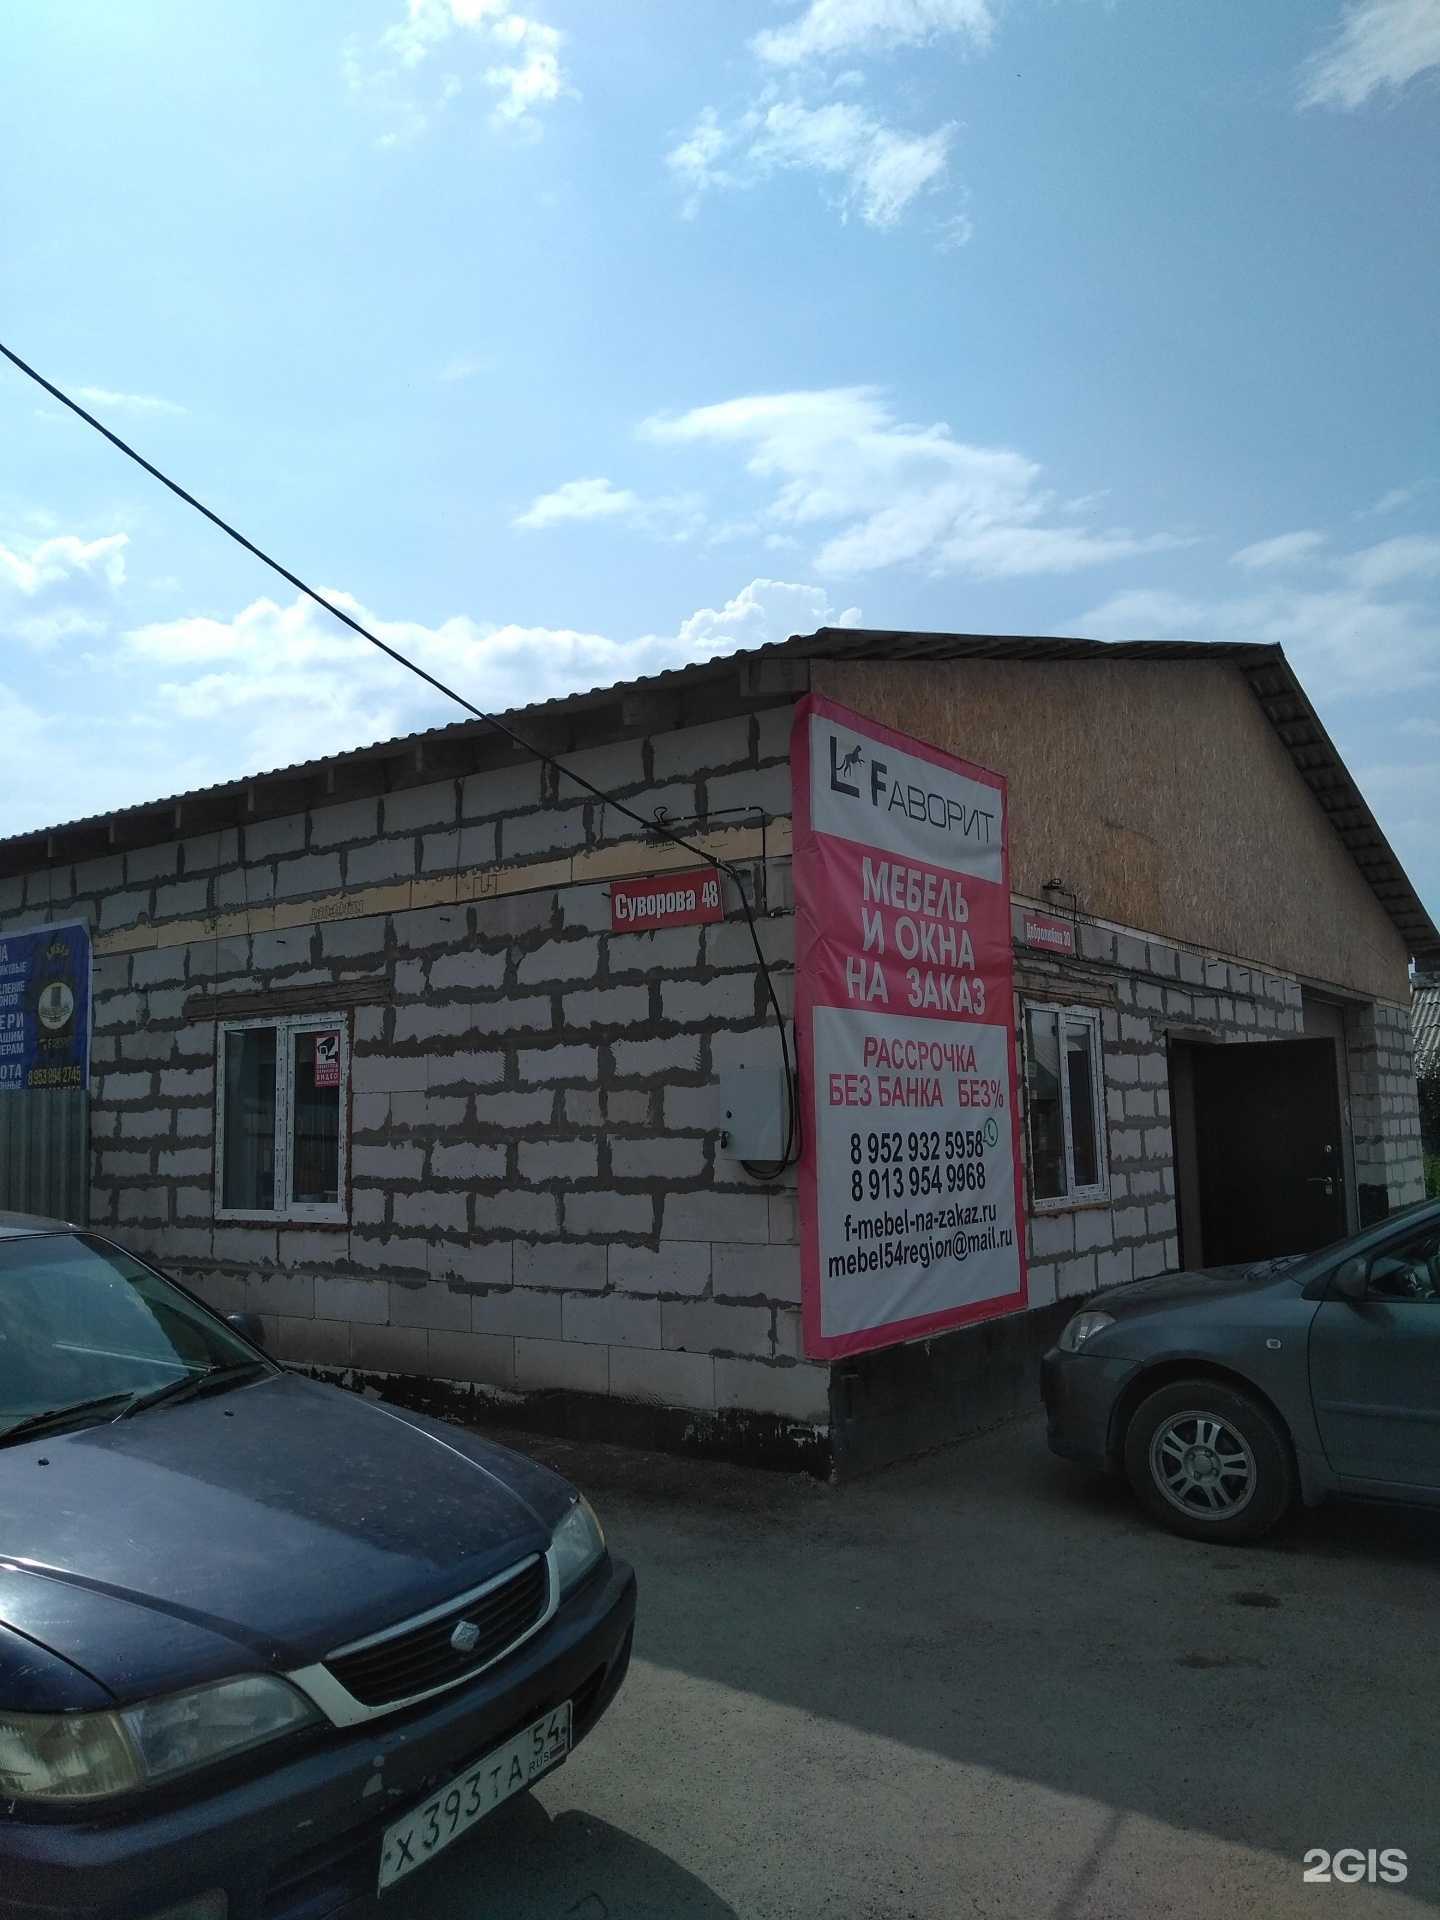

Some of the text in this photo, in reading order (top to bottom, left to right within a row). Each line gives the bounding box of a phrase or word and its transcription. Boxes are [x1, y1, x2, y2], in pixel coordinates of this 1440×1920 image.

[615, 880, 719, 921] Суворова 48
[862, 855, 969, 923] МЕБЕЛЬ
[861, 906, 976, 970] И ОКНА
[846, 956, 986, 1015] НА ЗАКАЗ
[0, 1042, 25, 1056] ЕРАМ
[863, 1036, 978, 1073] РАССРОЧКА
[829, 1073, 872, 1106] БЕЗ
[878, 1076, 944, 1109] БАНКА
[850, 1129, 984, 1164] 8 952 932 5958
[851, 1161, 986, 1202] 8 913 954 9968
[844, 1202, 997, 1242] f-mebel-na-zakaz.ru
[828, 1227, 1013, 1278] mebel54region@mail.ru
[531, 1713, 559, 1754] 54
[527, 1751, 550, 1774] RUS
